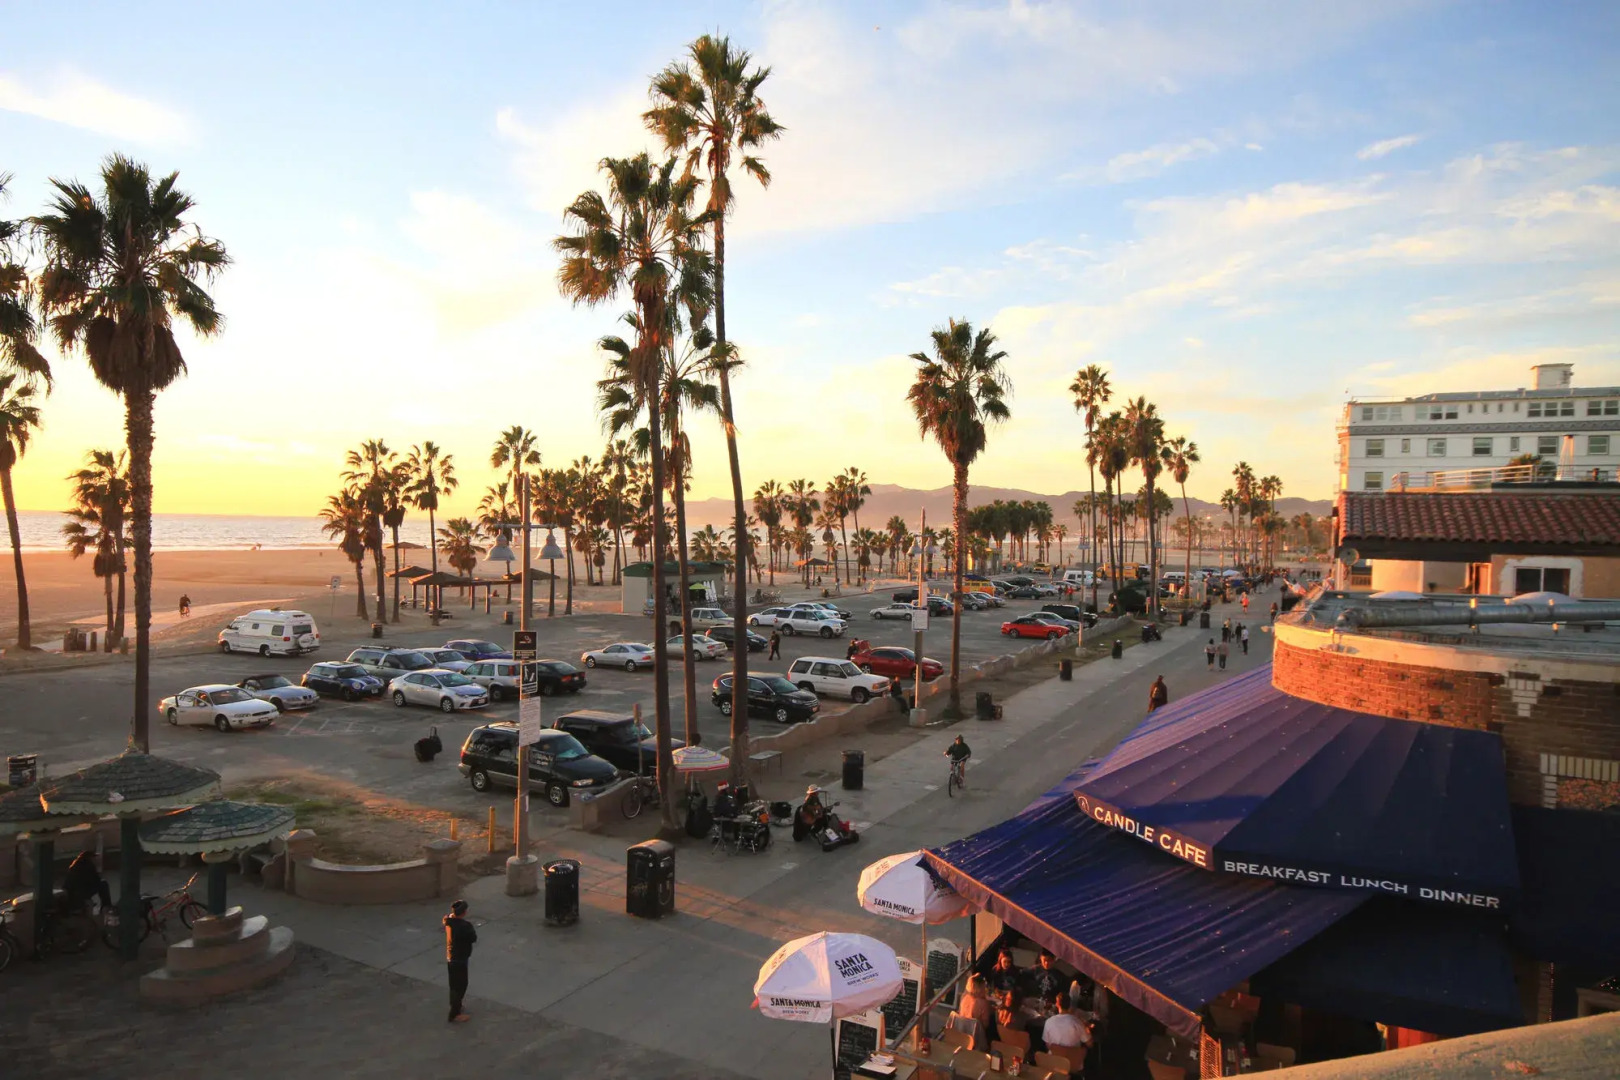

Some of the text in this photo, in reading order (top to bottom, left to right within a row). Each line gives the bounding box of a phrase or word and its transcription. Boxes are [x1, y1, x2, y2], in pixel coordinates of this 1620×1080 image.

[1094, 807, 1207, 867] CANDLE CAFE
[1224, 861, 1500, 908] BREAKFAST LUNCH DINNER
[873, 898, 892, 909] SANTA
[893, 903, 915, 915] MONICA
[834, 953, 868, 970] SANTA
[840, 961, 874, 978] MONICA
[770, 997, 821, 1008] SANTA MONICA
